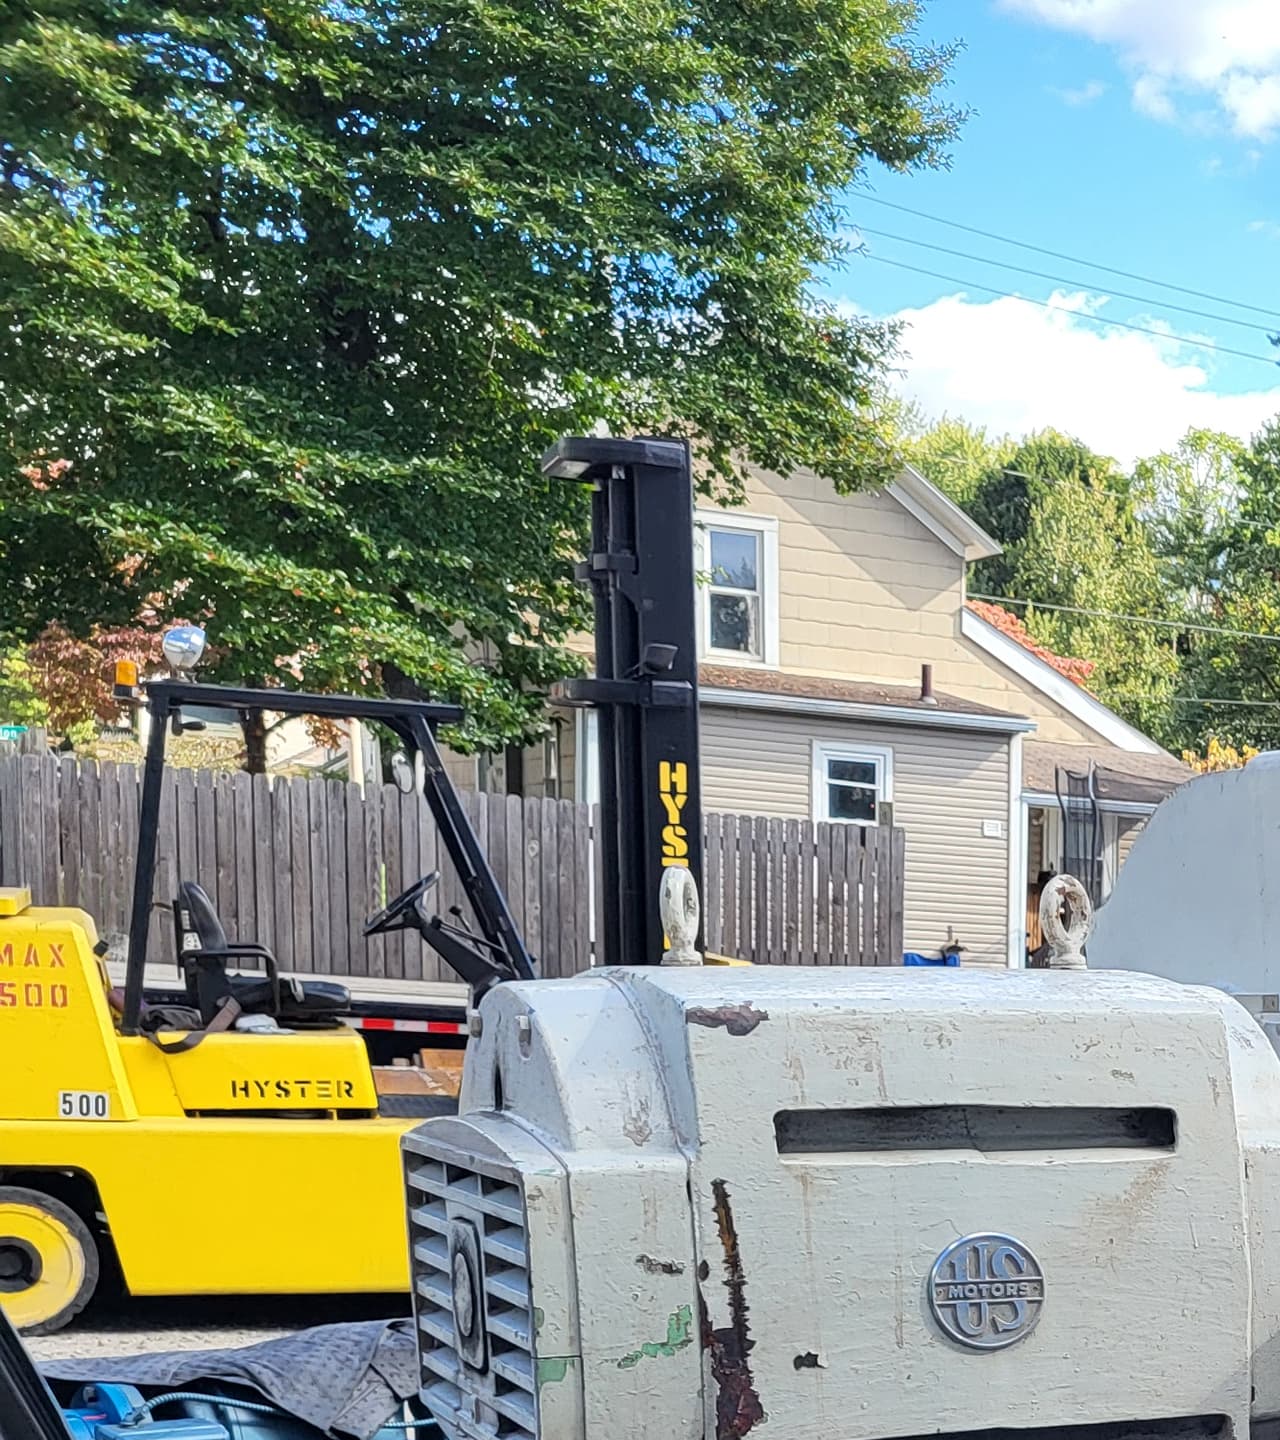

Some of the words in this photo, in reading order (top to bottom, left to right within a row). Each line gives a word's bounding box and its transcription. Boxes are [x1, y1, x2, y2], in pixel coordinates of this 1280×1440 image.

[231, 1080, 354, 1098] HYSTER
[62, 1093, 106, 1117] 500
[949, 1282, 1029, 1299] MOTORS
